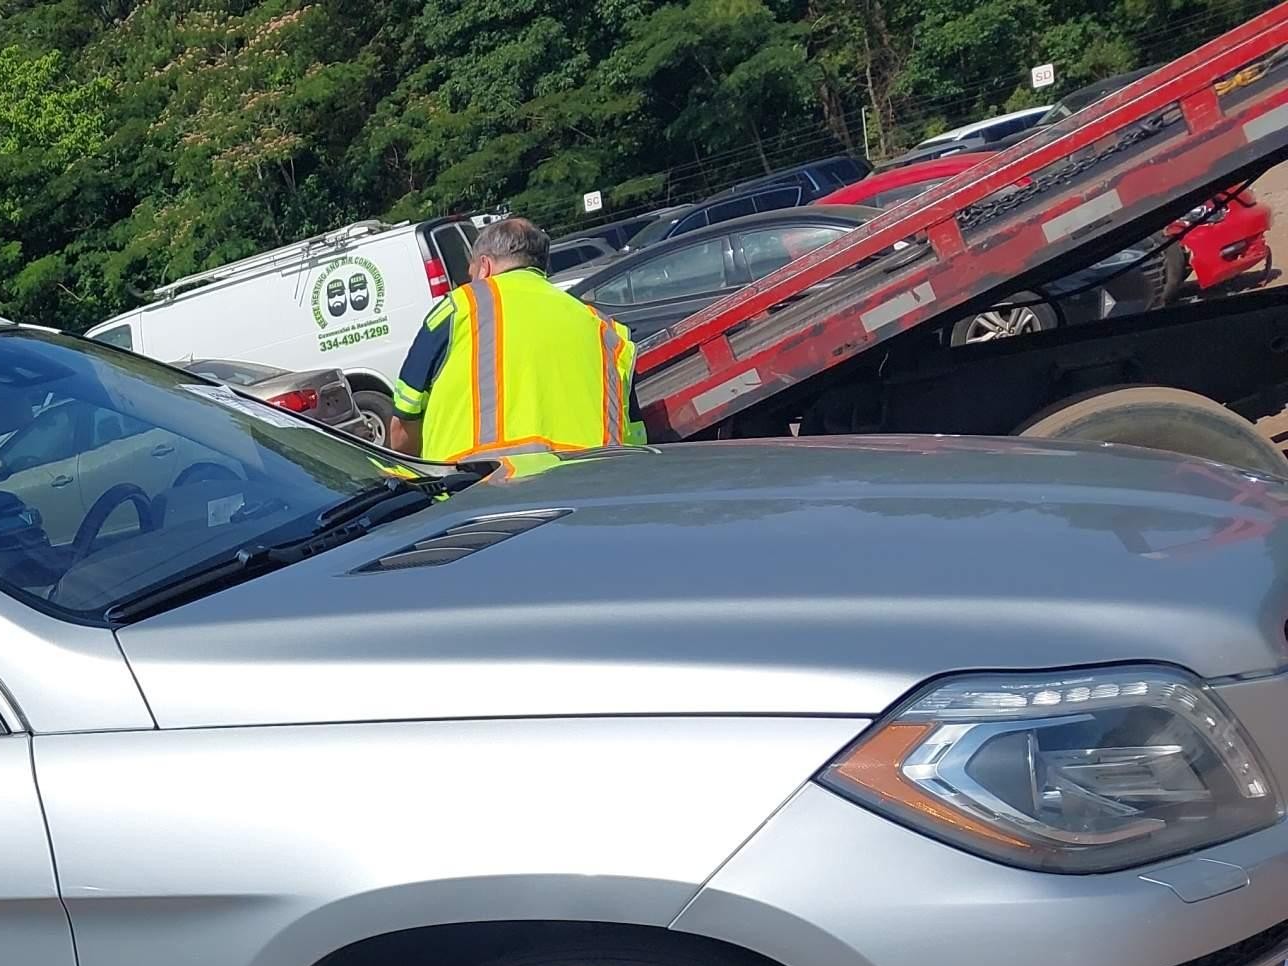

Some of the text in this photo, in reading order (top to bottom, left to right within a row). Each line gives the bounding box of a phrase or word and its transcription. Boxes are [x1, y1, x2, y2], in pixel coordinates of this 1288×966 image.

[1035, 71, 1052, 82] SD
[586, 196, 600, 207] SC
[312, 273, 327, 306] HEATING
[325, 261, 340, 275] AND
[341, 256, 354, 265] AIR
[354, 256, 385, 298] CONDITIONING
[320, 325, 389, 352] 334-430-1299
